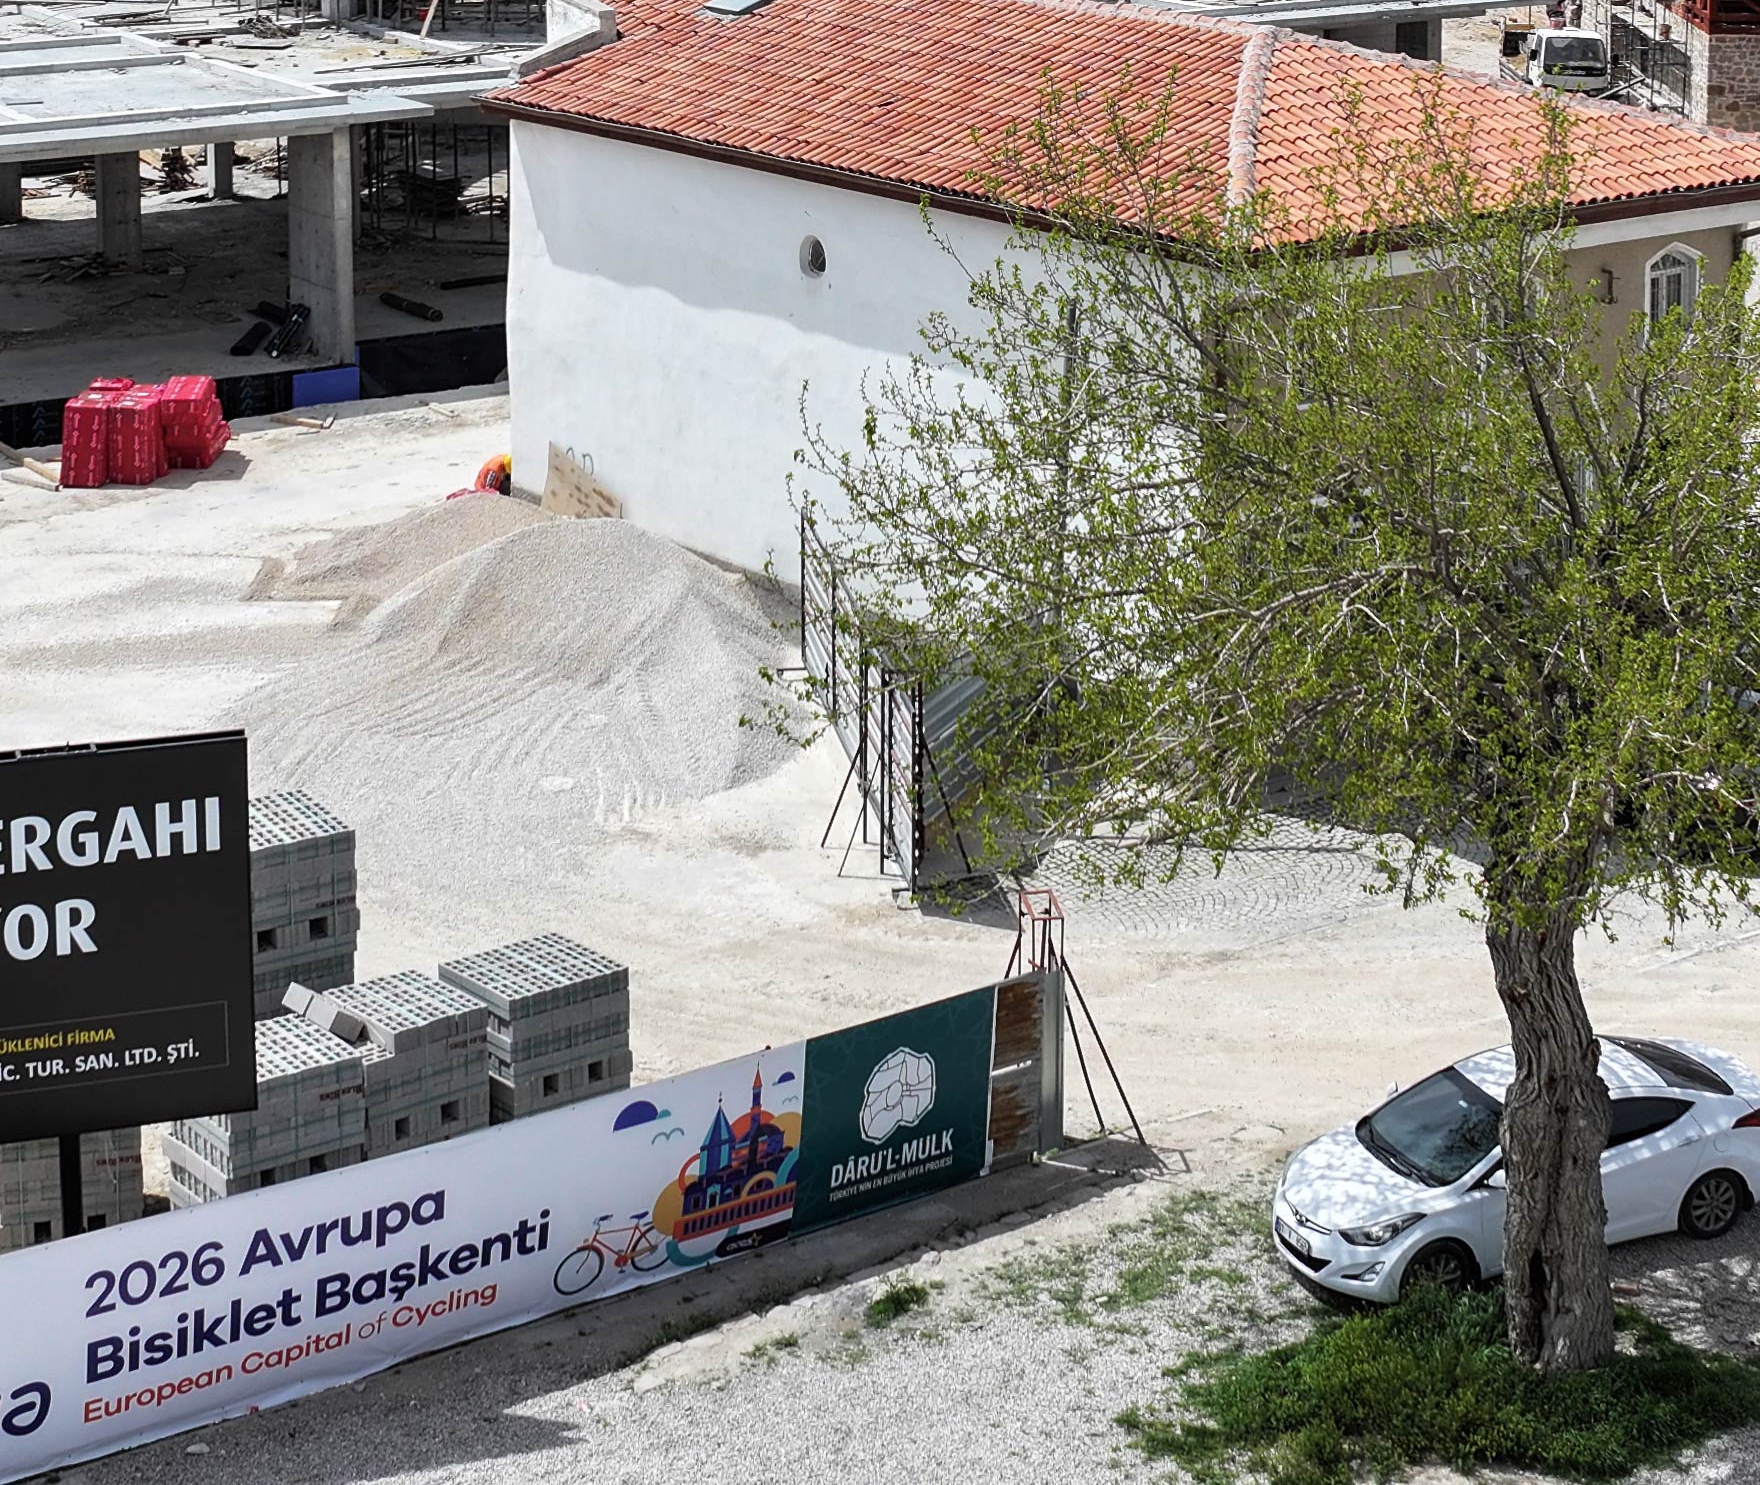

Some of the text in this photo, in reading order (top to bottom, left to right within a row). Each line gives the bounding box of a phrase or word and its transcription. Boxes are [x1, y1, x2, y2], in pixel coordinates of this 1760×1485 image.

[26, 1057, 71, 1078] TUR.
[75, 1051, 119, 1073] SAN.
[124, 1045, 163, 1066] LTD.
[166, 1037, 201, 1066] ŞTİ.
[67, 1026, 117, 1047] FİRMA
[84, 1186, 448, 1319] 2026 Avrupa
[85, 1209, 552, 1385] Bisiklet Başkenti
[82, 1282, 500, 1426] European Capital of Cycling
